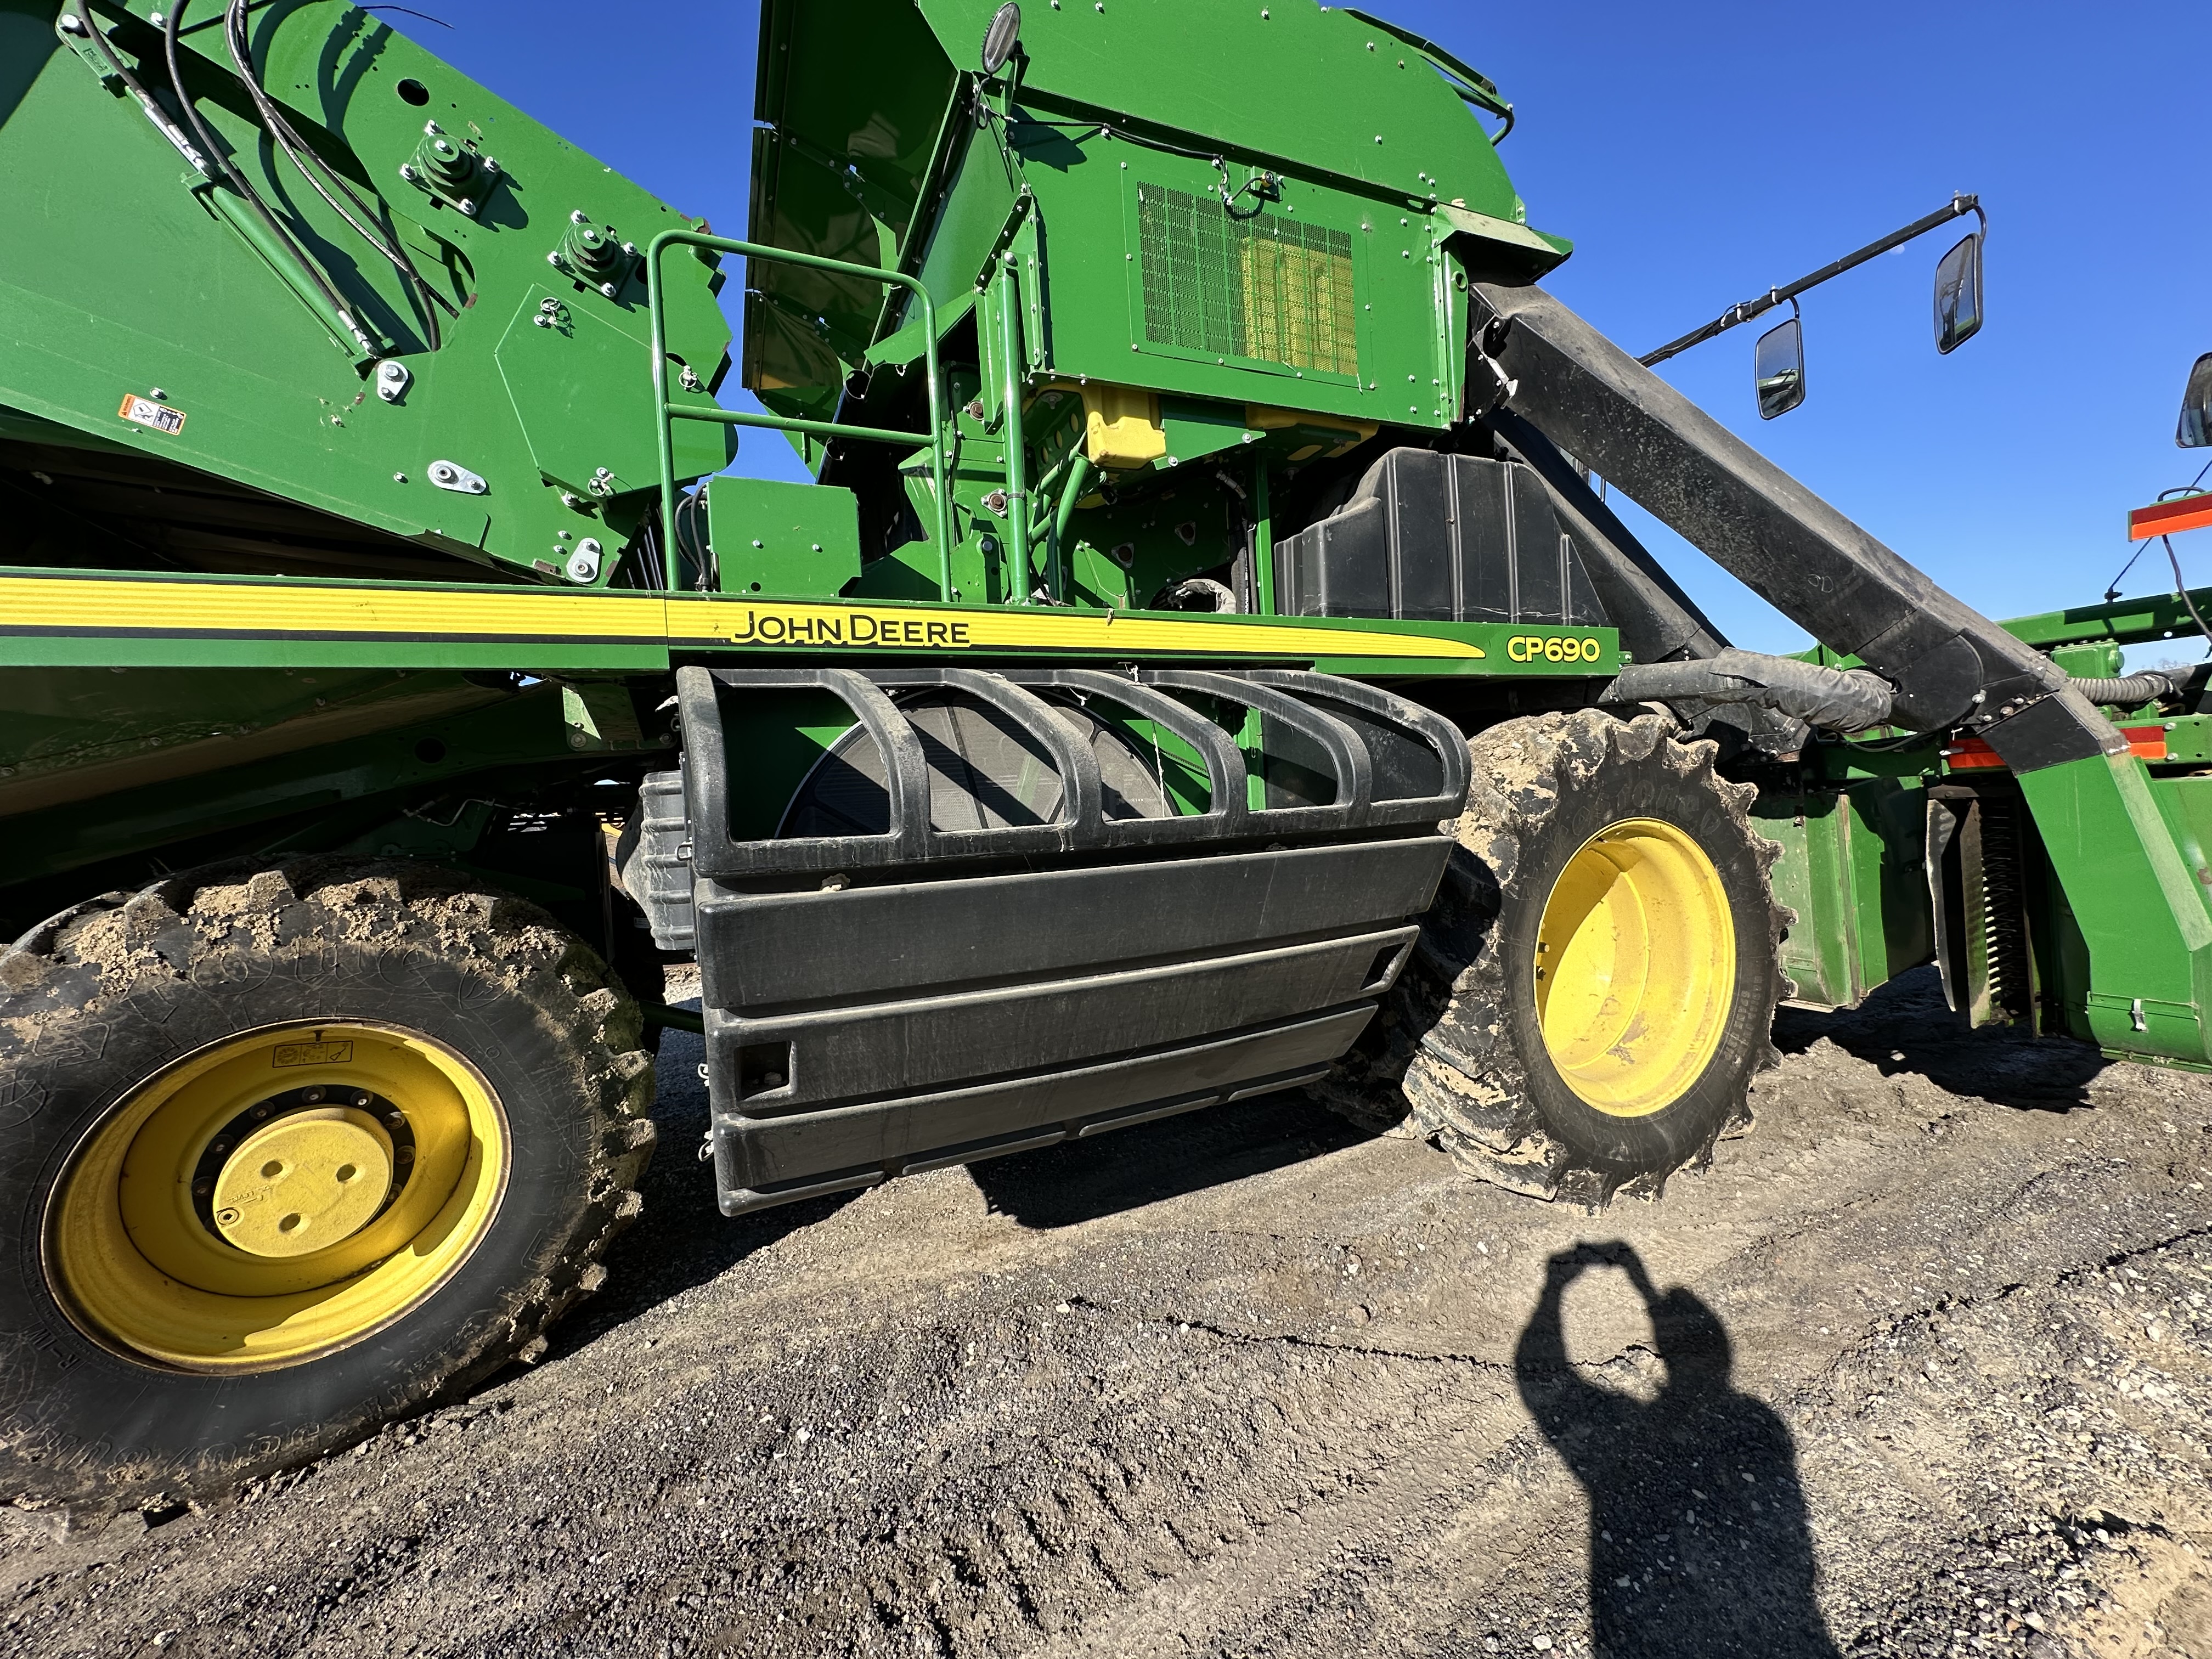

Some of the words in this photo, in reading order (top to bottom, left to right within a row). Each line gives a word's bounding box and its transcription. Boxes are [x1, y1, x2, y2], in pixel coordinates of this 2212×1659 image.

[735, 611, 842, 641] JOHN
[850, 614, 970, 644] DEERE
[1507, 635, 1600, 663] CP690
